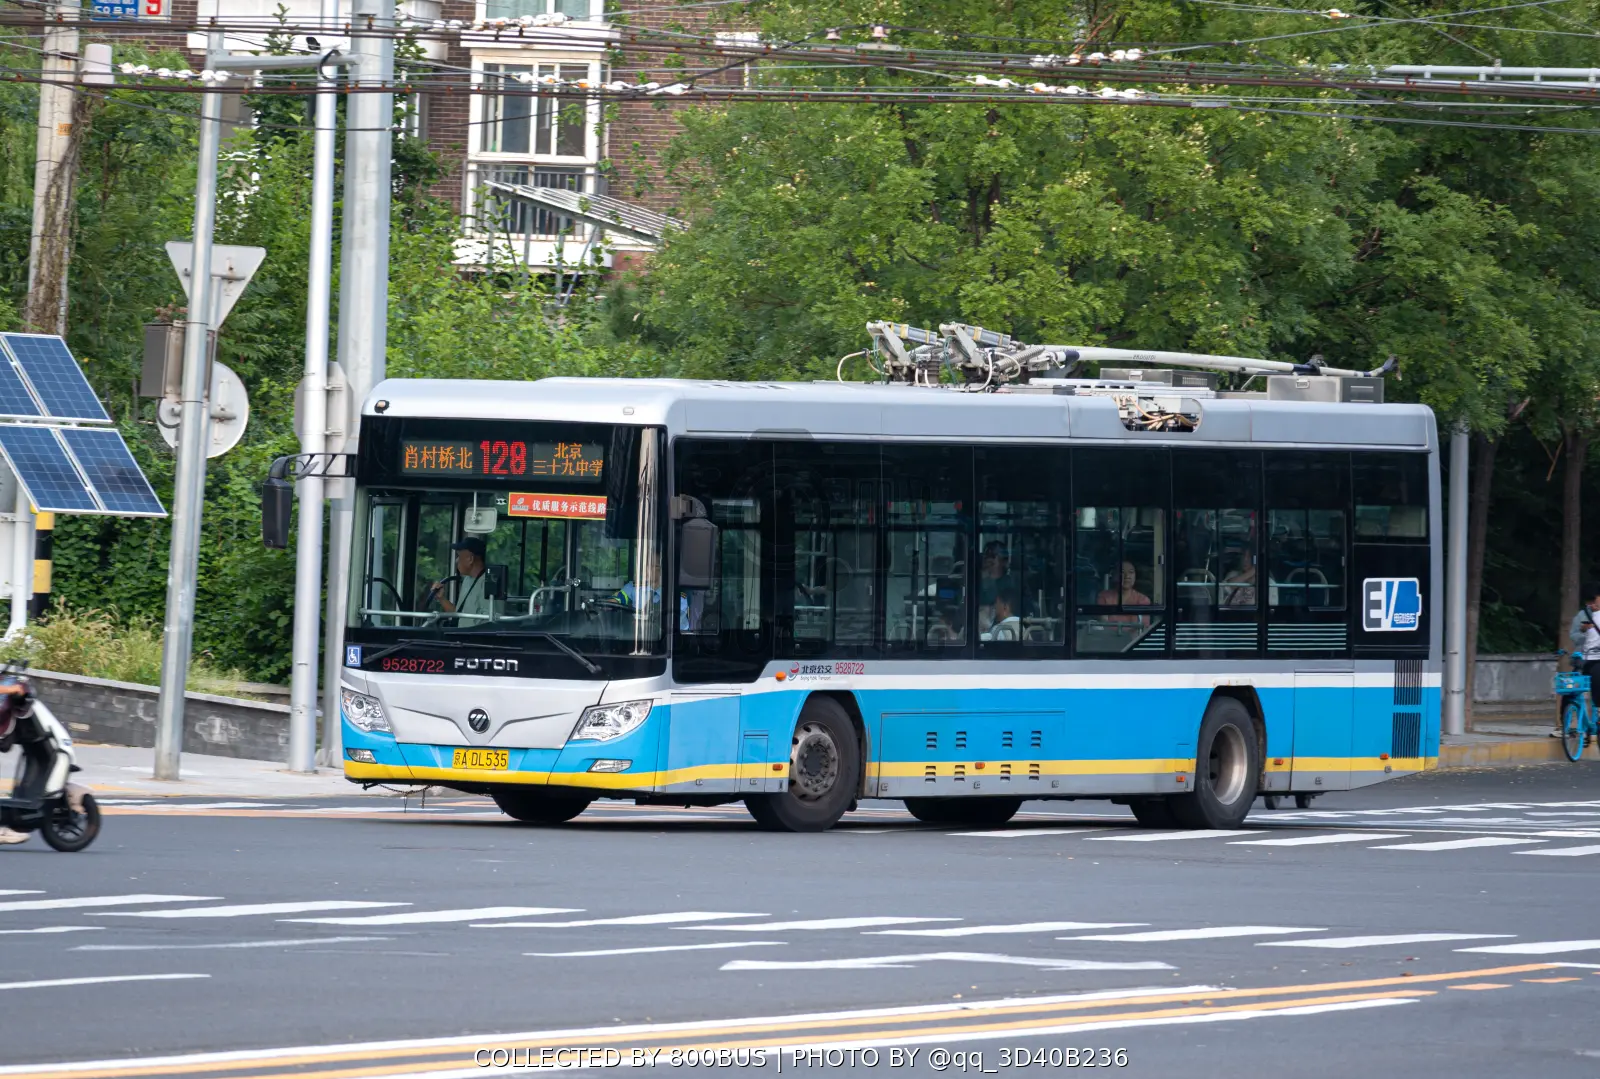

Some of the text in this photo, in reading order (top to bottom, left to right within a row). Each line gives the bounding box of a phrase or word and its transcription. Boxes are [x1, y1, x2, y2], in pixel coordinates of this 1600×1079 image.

[404, 445, 473, 470] 肖村桥北
[480, 440, 527, 475] 128
[554, 443, 583, 459] 北京
[533, 459, 604, 477] 三十九中学
[532, 499, 606, 515] 优质服务示范线路
[382, 657, 445, 673] 9528722
[454, 657, 519, 672] FOTON
[801, 664, 832, 675] 北京公交
[835, 662, 865, 675] 9528722
